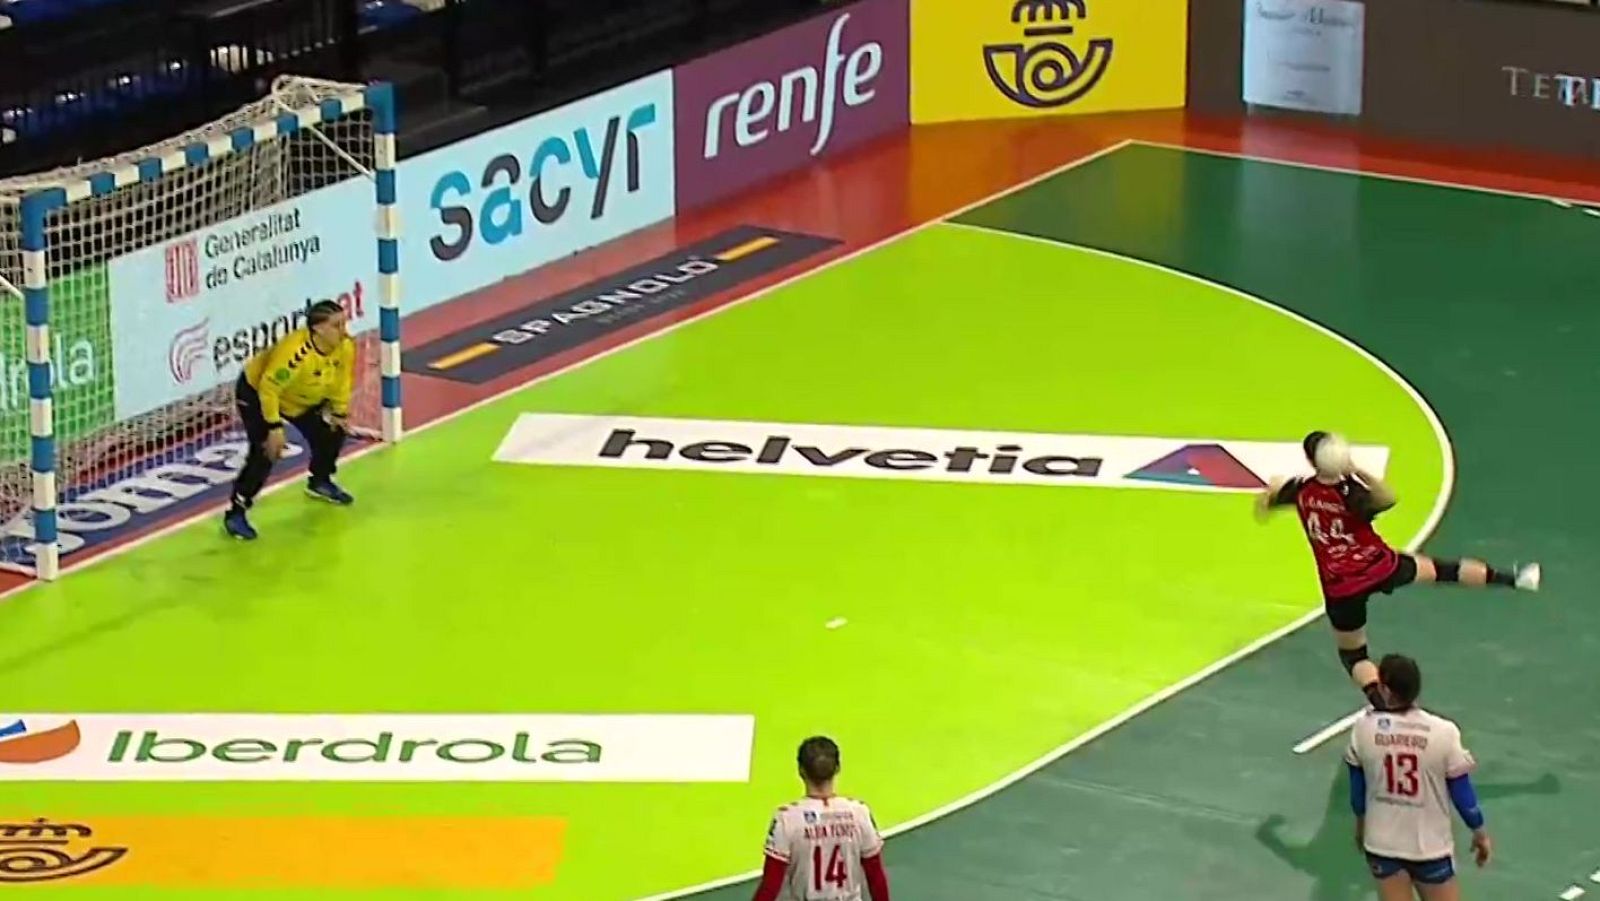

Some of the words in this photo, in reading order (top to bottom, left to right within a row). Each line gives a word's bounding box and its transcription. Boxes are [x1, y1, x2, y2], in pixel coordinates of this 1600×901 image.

[704, 12, 883, 158] renfe
[430, 103, 656, 261] sacyr
[205, 207, 300, 258] Generalitat
[206, 264, 228, 289] de
[233, 234, 320, 280] Catalunya
[213, 280, 365, 372] esporat
[493, 255, 719, 345] SPAGNOLO
[598, 429, 1104, 477] helvetia
[107, 731, 603, 764] Iberdrola
[1384, 753, 1419, 797] 13
[814, 844, 848, 891] 14
